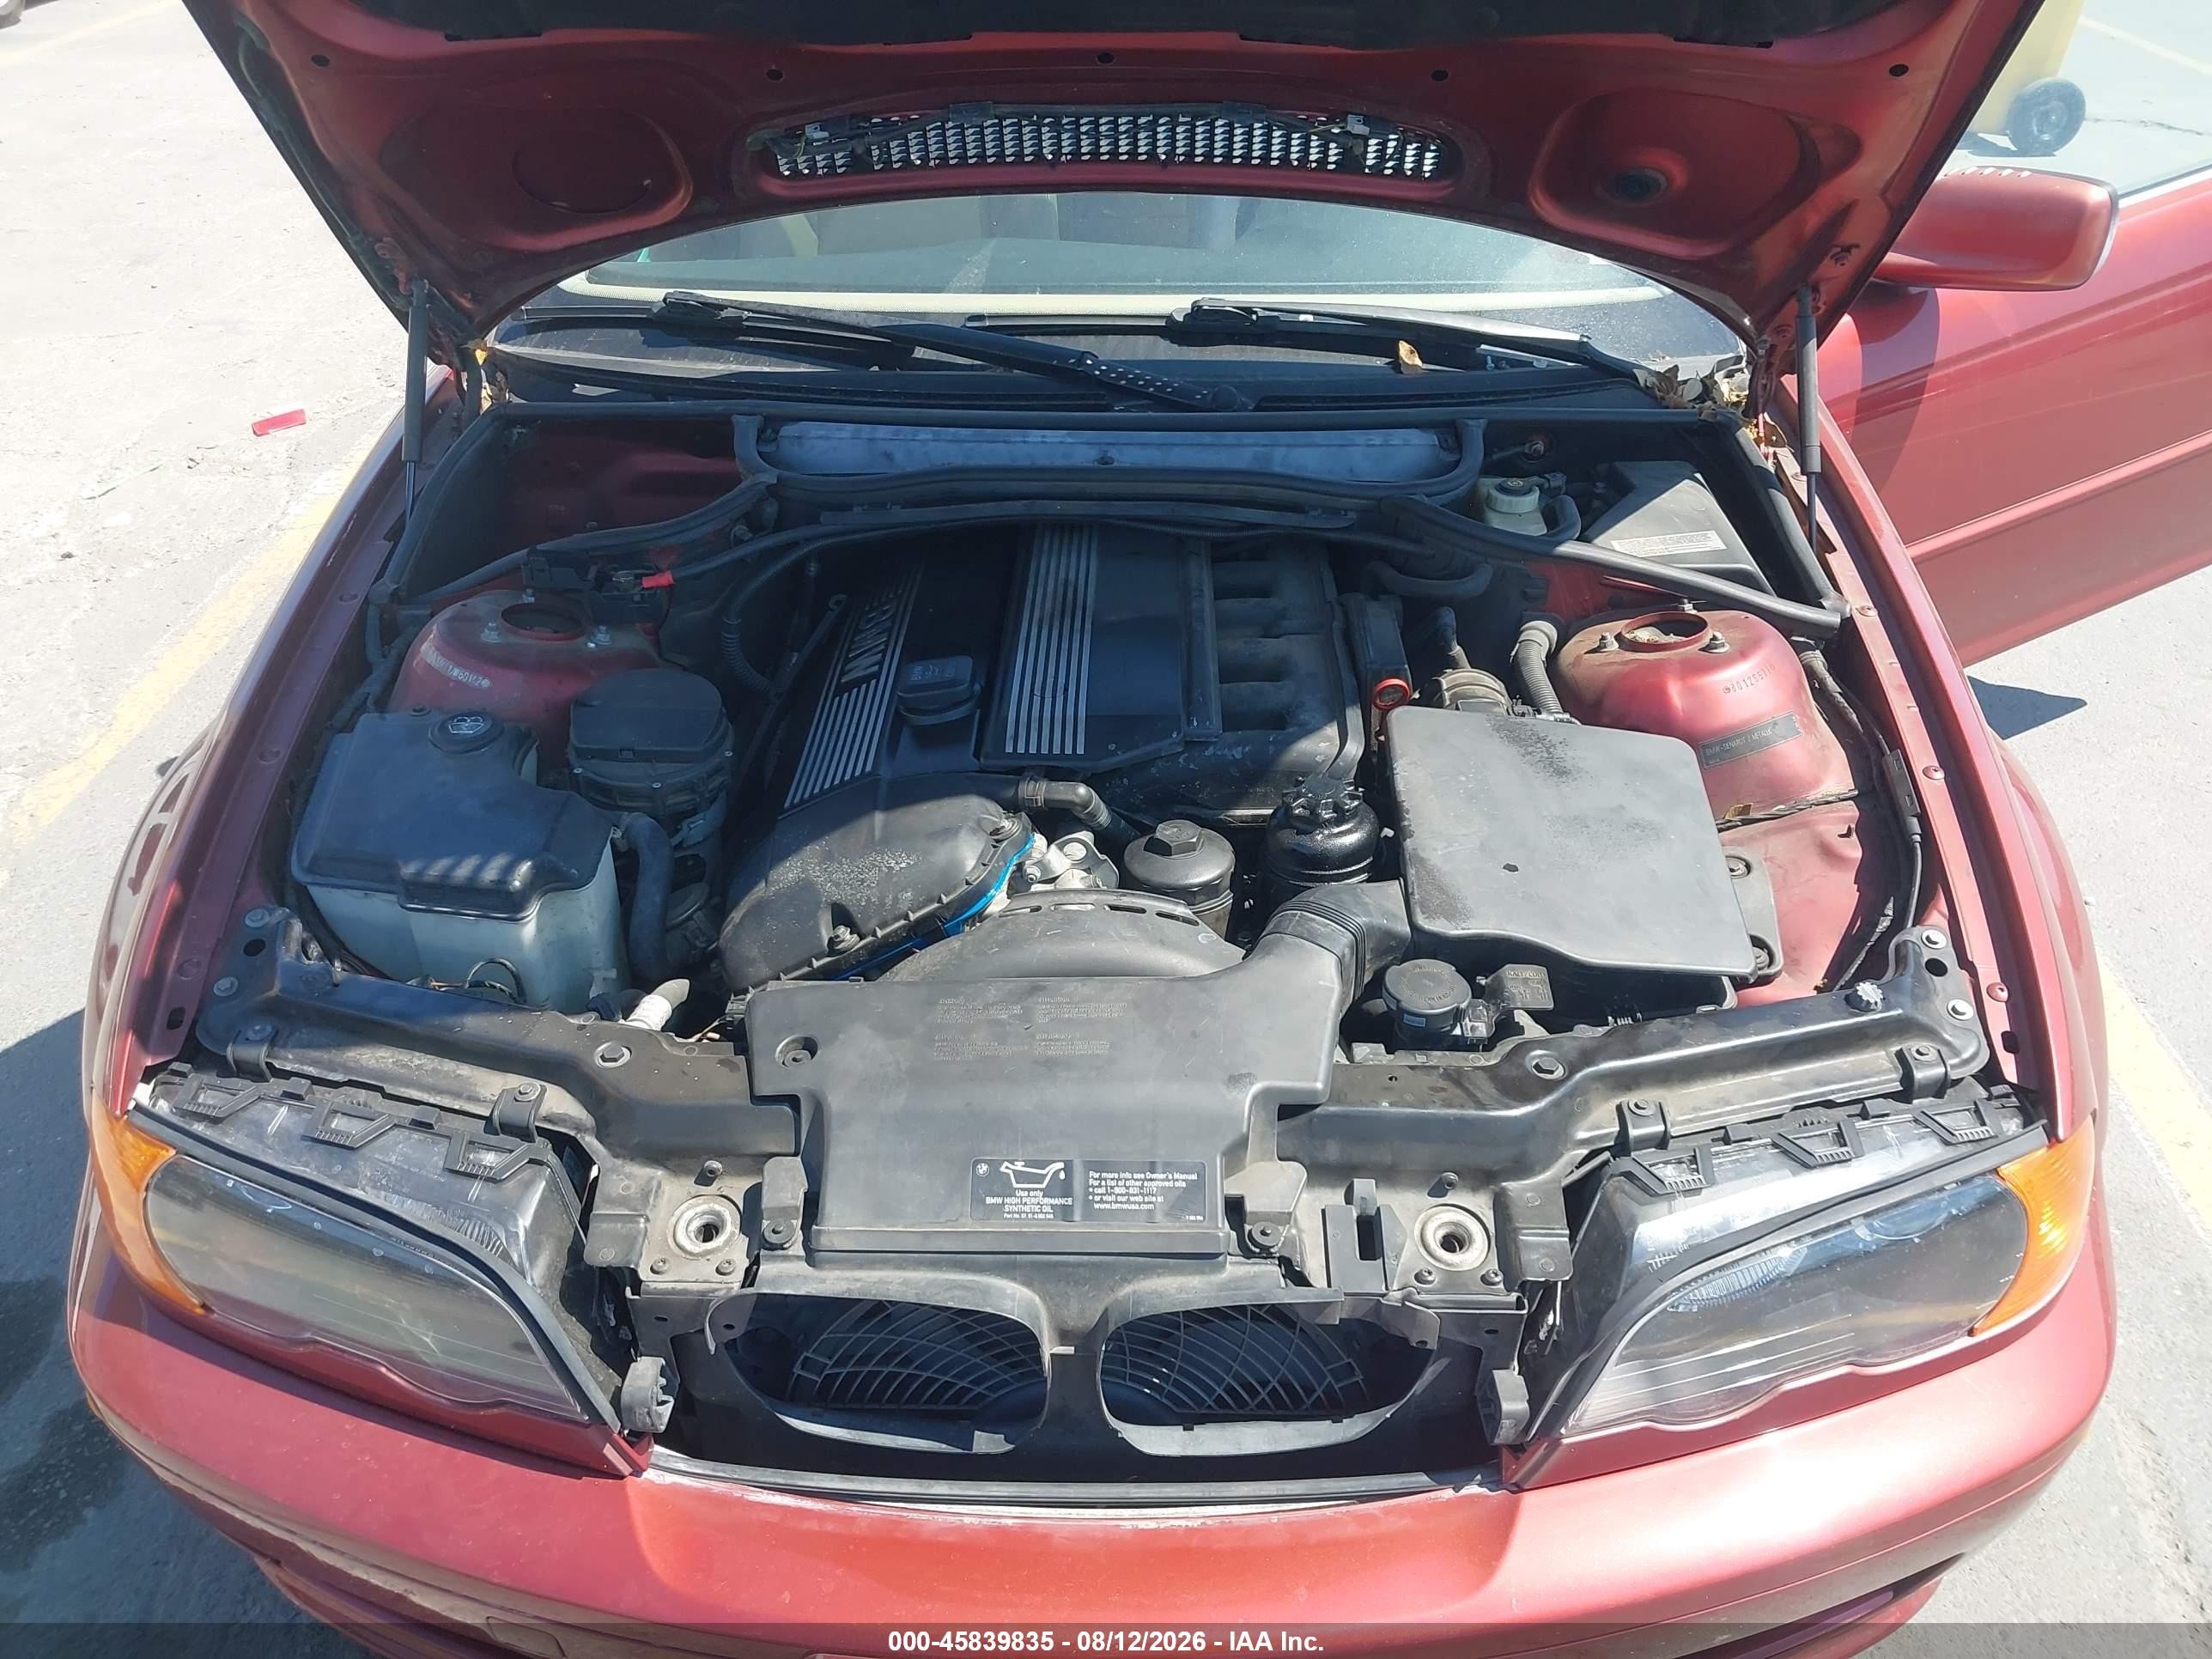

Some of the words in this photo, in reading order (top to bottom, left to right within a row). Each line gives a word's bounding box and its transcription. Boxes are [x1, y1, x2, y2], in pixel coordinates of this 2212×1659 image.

[1143, 1180, 1174, 1188] approved
[1029, 1189, 1043, 1199] only
[1022, 1197, 1073, 1206] PERFORMANCE
